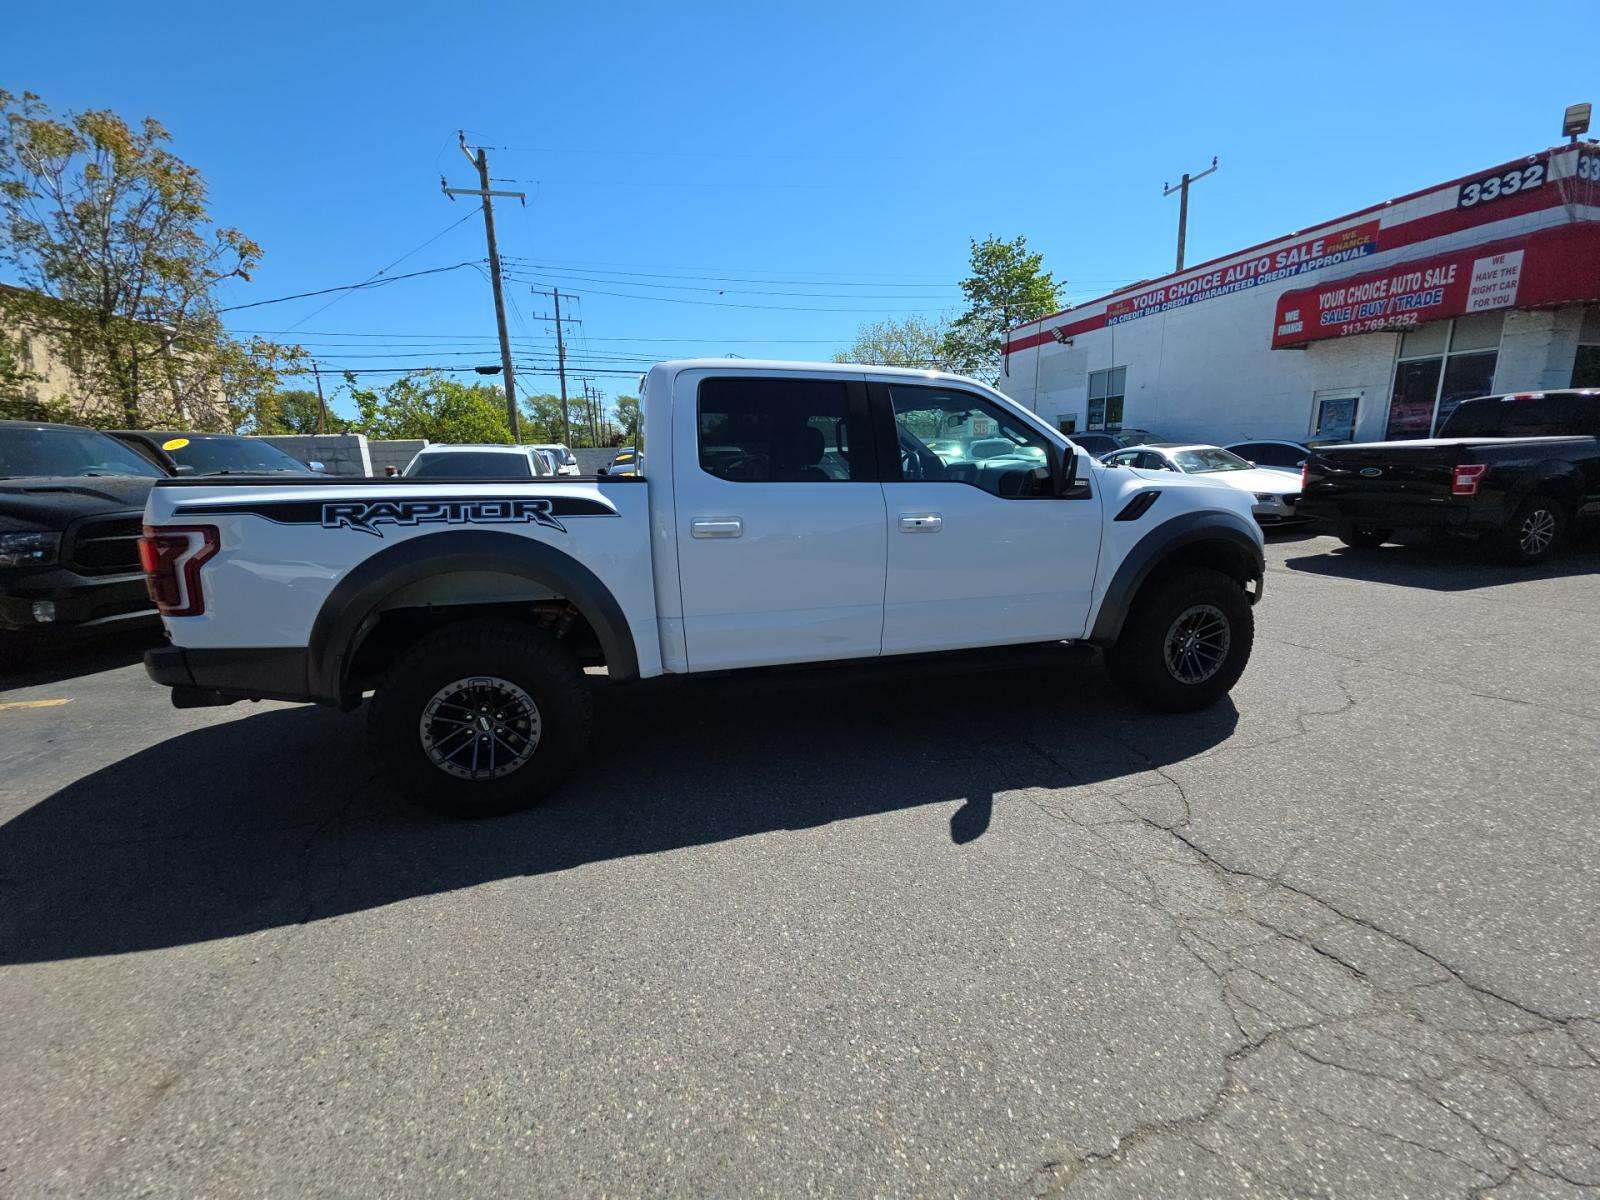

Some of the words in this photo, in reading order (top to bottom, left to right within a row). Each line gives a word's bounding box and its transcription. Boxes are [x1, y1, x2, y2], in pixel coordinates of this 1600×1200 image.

[1461, 165, 1544, 207] 3332
[1327, 234, 1371, 253] FINANCE
[1492, 255, 1505, 265] WE
[1133, 290, 1165, 309] YOUR
[1168, 271, 1222, 299] CHOICE
[1225, 257, 1270, 282] AUTO
[1276, 240, 1324, 268] SALE
[1475, 269, 1498, 282] HAVE
[1501, 265, 1518, 277] THE
[1108, 316, 1118, 326] NO
[1119, 309, 1144, 322] CREDIT
[1145, 304, 1160, 316] BAD
[1161, 295, 1191, 311] CREDIT
[1192, 277, 1255, 302] GUARANTEED
[1257, 265, 1297, 285] CREDIT
[1300, 245, 1368, 273] APPROVAL
[1319, 289, 1345, 310] YOUR
[1347, 279, 1388, 305] CHOICE
[1389, 271, 1422, 295] AUTO
[1424, 264, 1457, 291] SALE
[1471, 284, 1497, 296] RIGHT
[1499, 280, 1518, 290] CAR
[1320, 306, 1352, 327] SALE
[1359, 299, 1387, 318] BUY
[1396, 287, 1444, 311] TRADE
[1473, 296, 1491, 308] FOR
[1492, 294, 1510, 305] YOU
[1285, 309, 1300, 322] WE
[1340, 312, 1418, 336] 313-769-5252
[1277, 321, 1303, 337] FINANCE
[321, 499, 568, 539] RAPTOR
